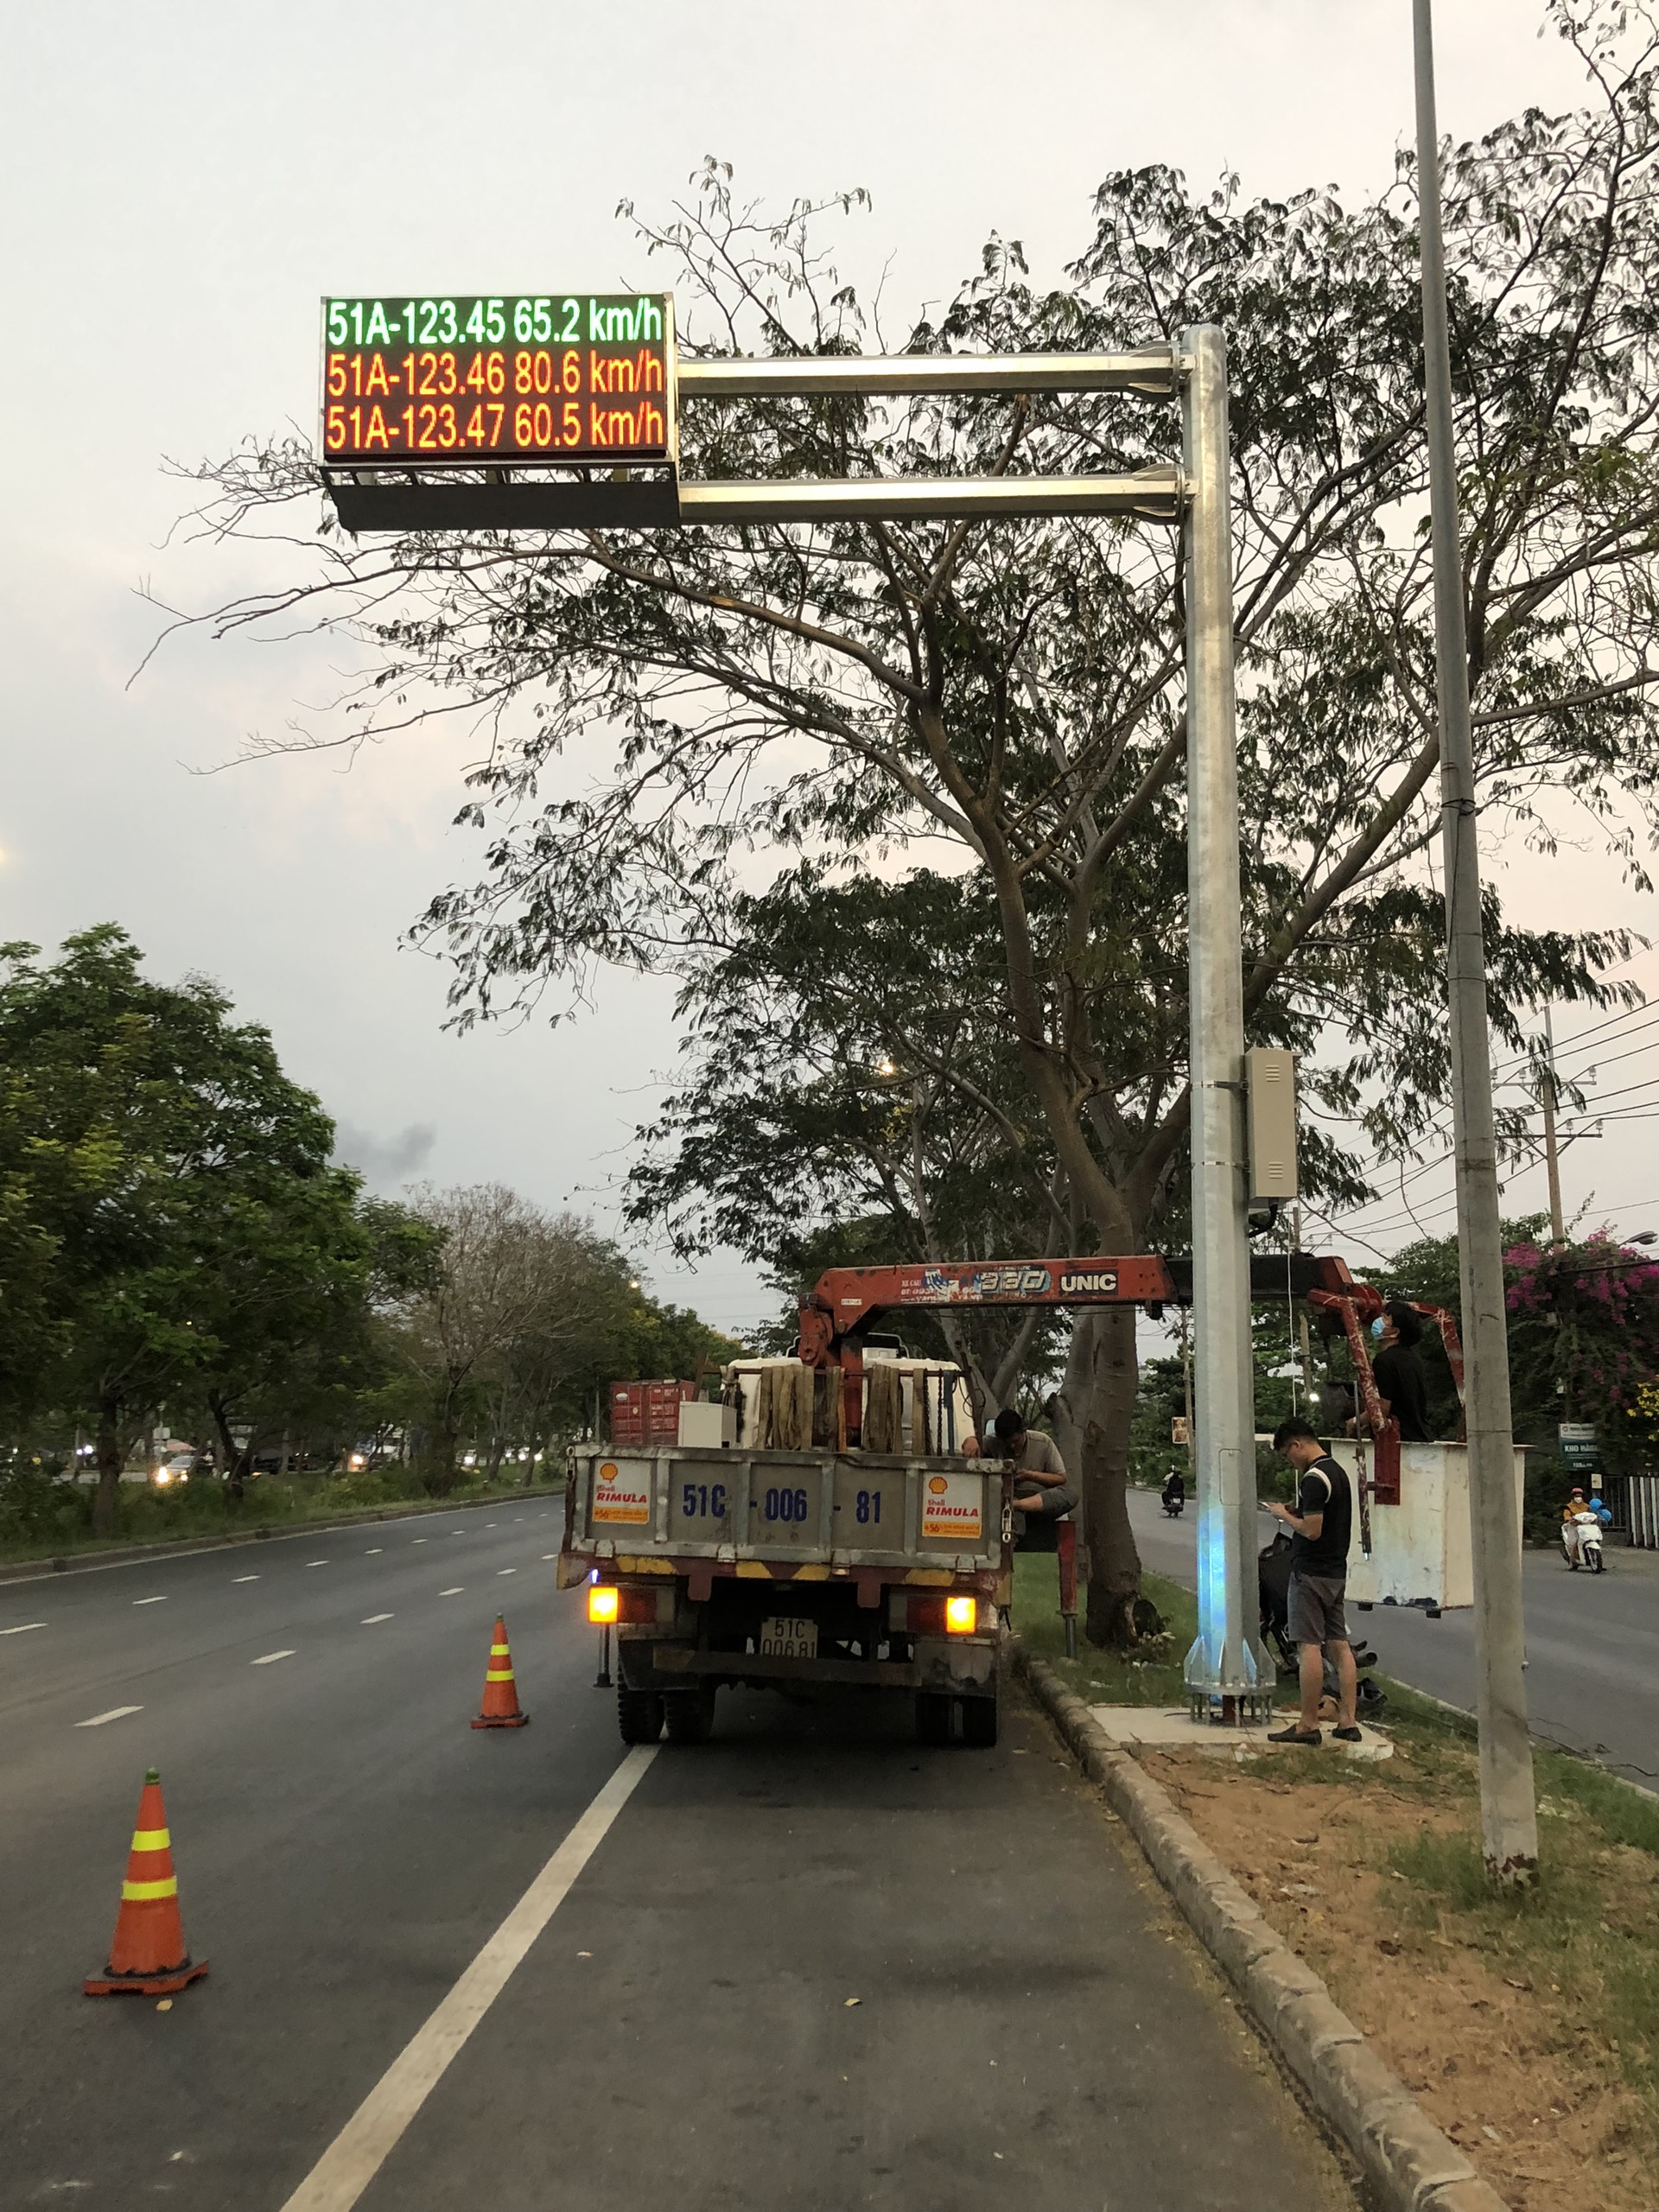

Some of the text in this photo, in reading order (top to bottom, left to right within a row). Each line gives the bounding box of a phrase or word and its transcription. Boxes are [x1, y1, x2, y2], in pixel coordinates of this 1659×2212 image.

[327, 297, 662, 345] 51A-123.45 65.2 km/h
[327, 349, 663, 397] 51A-123.46 80.6 km/h
[327, 401, 664, 448] 51A-123.47 60.5 km/h
[1061, 1274, 1116, 1292] UNIC
[597, 1492, 647, 1503] RIMULA
[683, 1484, 726, 1517] 51C
[766, 1488, 807, 1522] 006
[856, 1491, 881, 1523] 81
[926, 1507, 978, 1516] RIMULA
[775, 1619, 804, 1638] 51C
